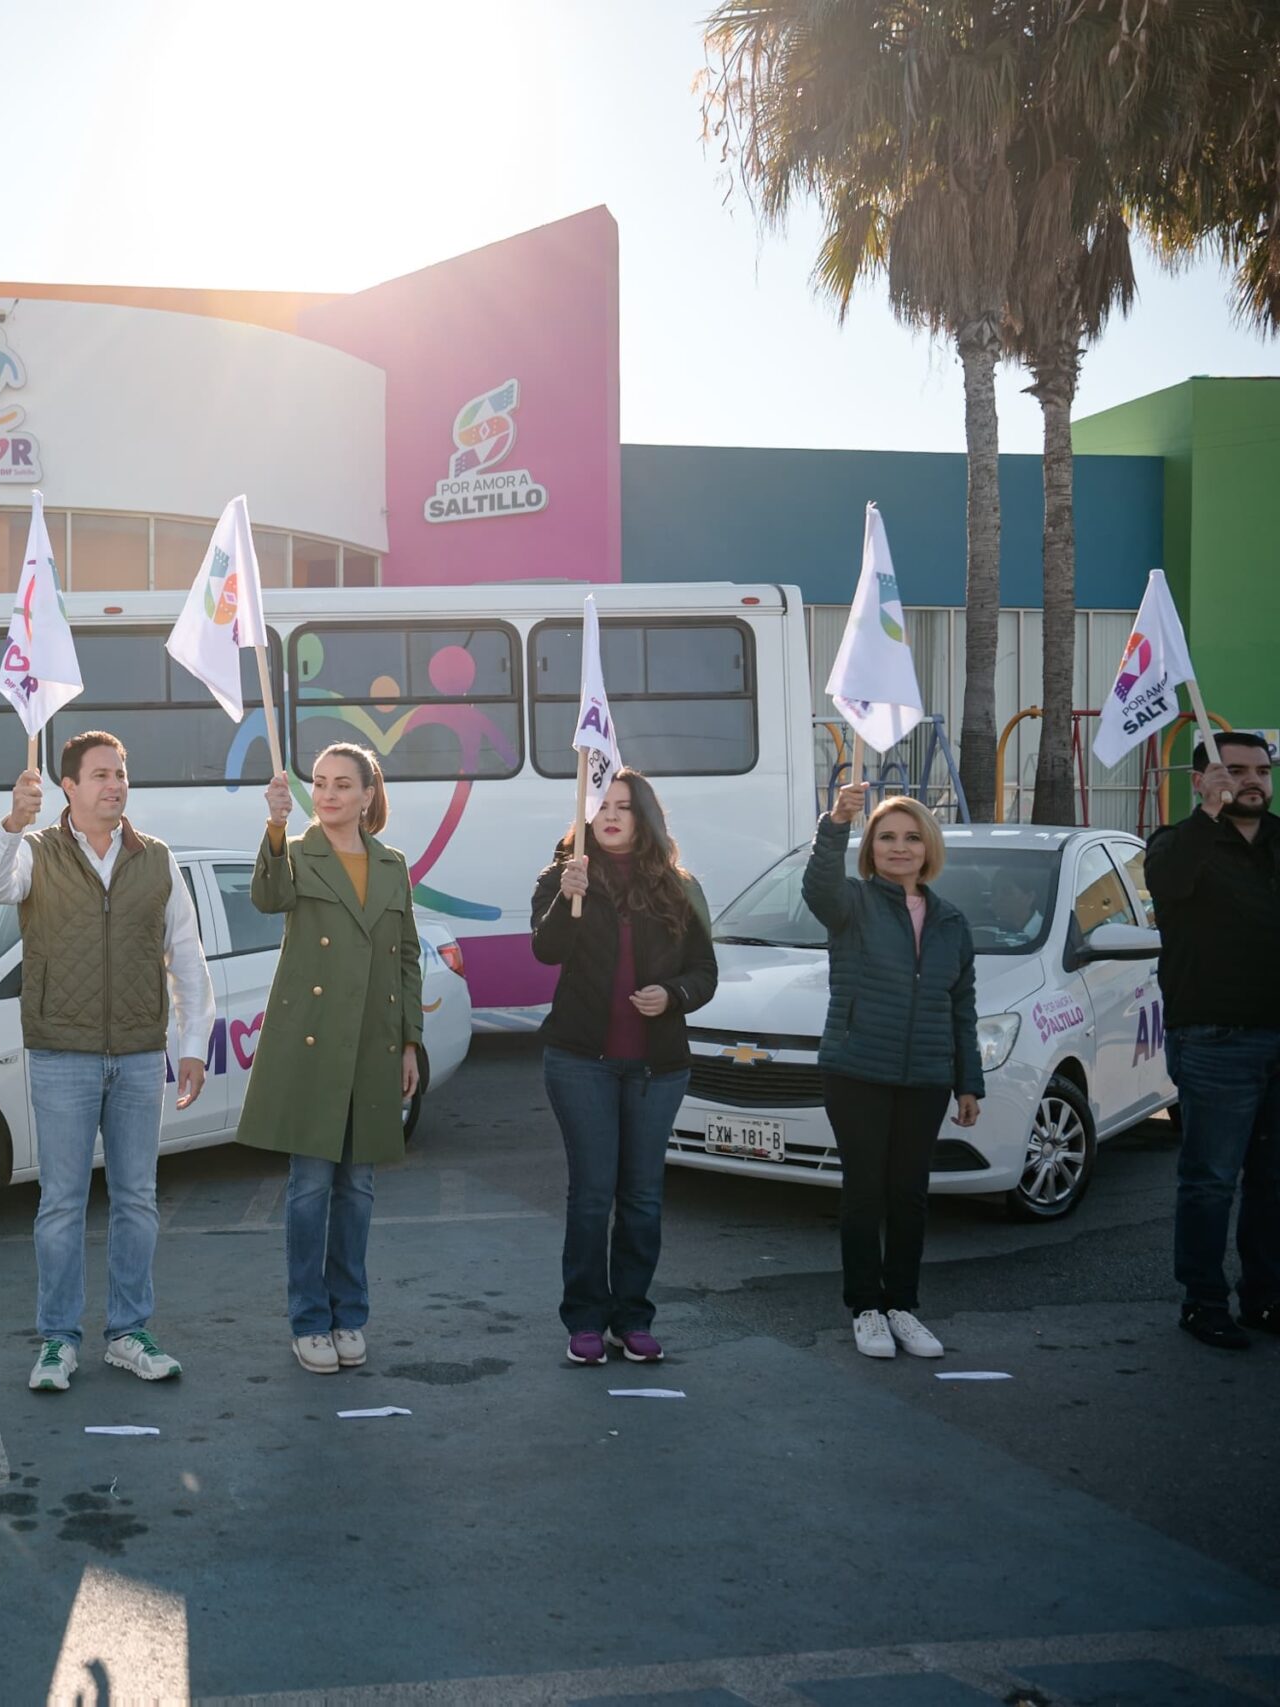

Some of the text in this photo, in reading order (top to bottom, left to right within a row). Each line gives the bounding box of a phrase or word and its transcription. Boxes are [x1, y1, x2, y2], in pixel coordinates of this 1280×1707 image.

[441, 473, 528, 496] POR AMOR A
[429, 488, 543, 518] SALTILLO
[4, 678, 16, 689] DIF
[1122, 695, 1147, 717] POR
[708, 1124, 780, 1150] EXW-181-B
